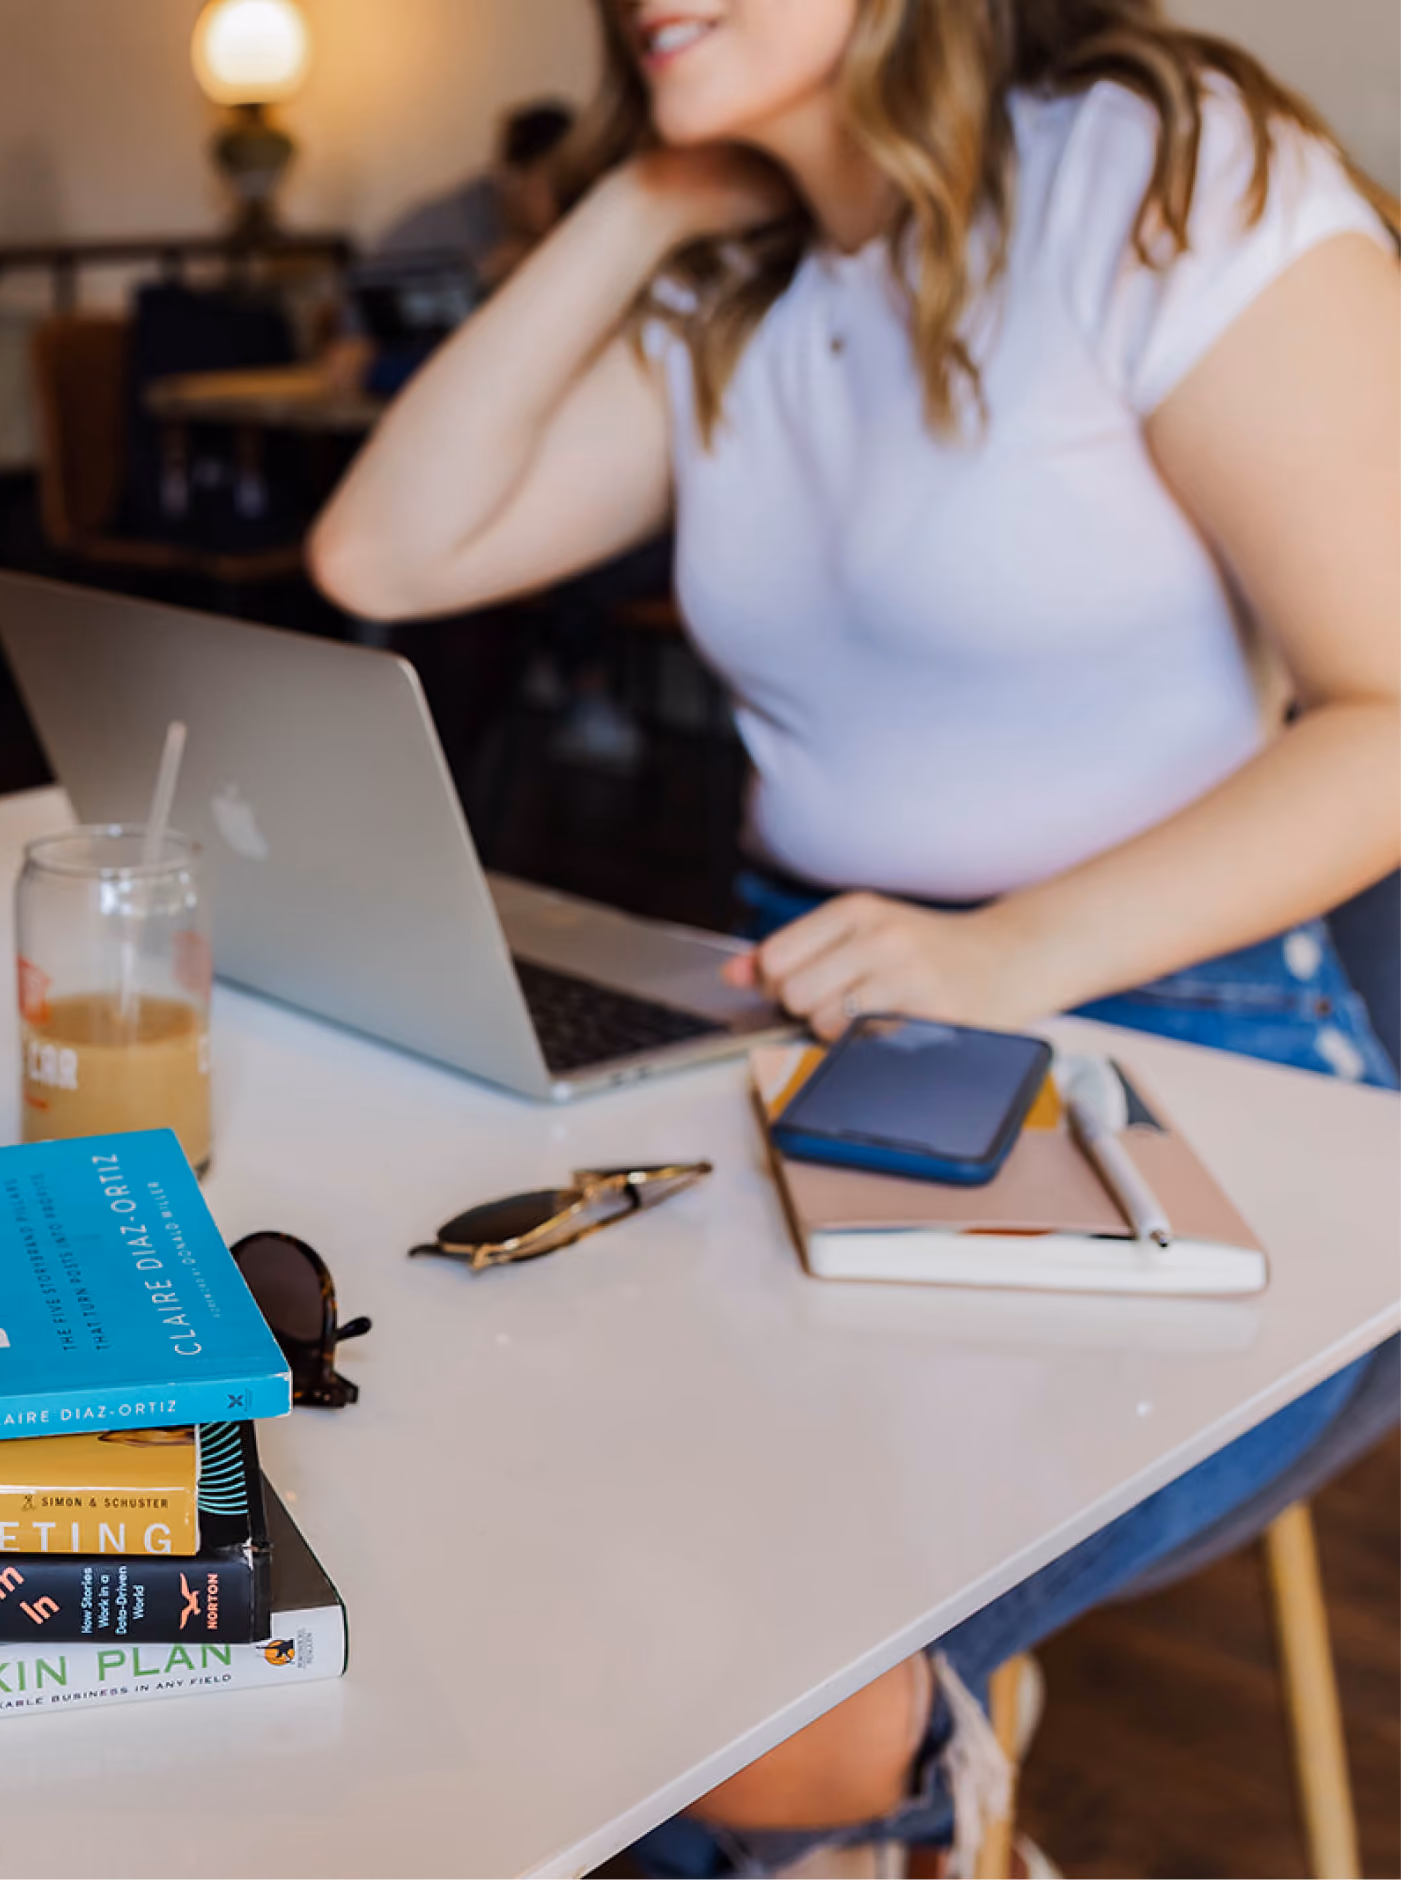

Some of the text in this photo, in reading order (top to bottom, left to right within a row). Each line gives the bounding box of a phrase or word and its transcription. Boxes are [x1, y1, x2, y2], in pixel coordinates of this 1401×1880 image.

[91, 1154, 202, 1355] CLAIRE DIAZ-ORTIZ
[165, 1223, 196, 1264] DONALD
[57, 1329, 76, 1351] THE
[60, 1400, 177, 1422] DIAZ-ORTIZ
[41, 1496, 168, 1510] SIMON & SCHUSTER
[19, 1593, 61, 1626] In
[81, 1567, 92, 1634] How Stories
[98, 1575, 109, 1628] Work in a
[115, 1566, 127, 1635] Data-Driven
[133, 1585, 144, 1619] World
[207, 1573, 218, 1629] NORTON
[98, 1644, 231, 1681] PLAN
[51, 1687, 129, 1703] BUSINESS
[135, 1684, 149, 1692] IN
[156, 1679, 184, 1690] ANY
[190, 1673, 232, 1685] FIELD
